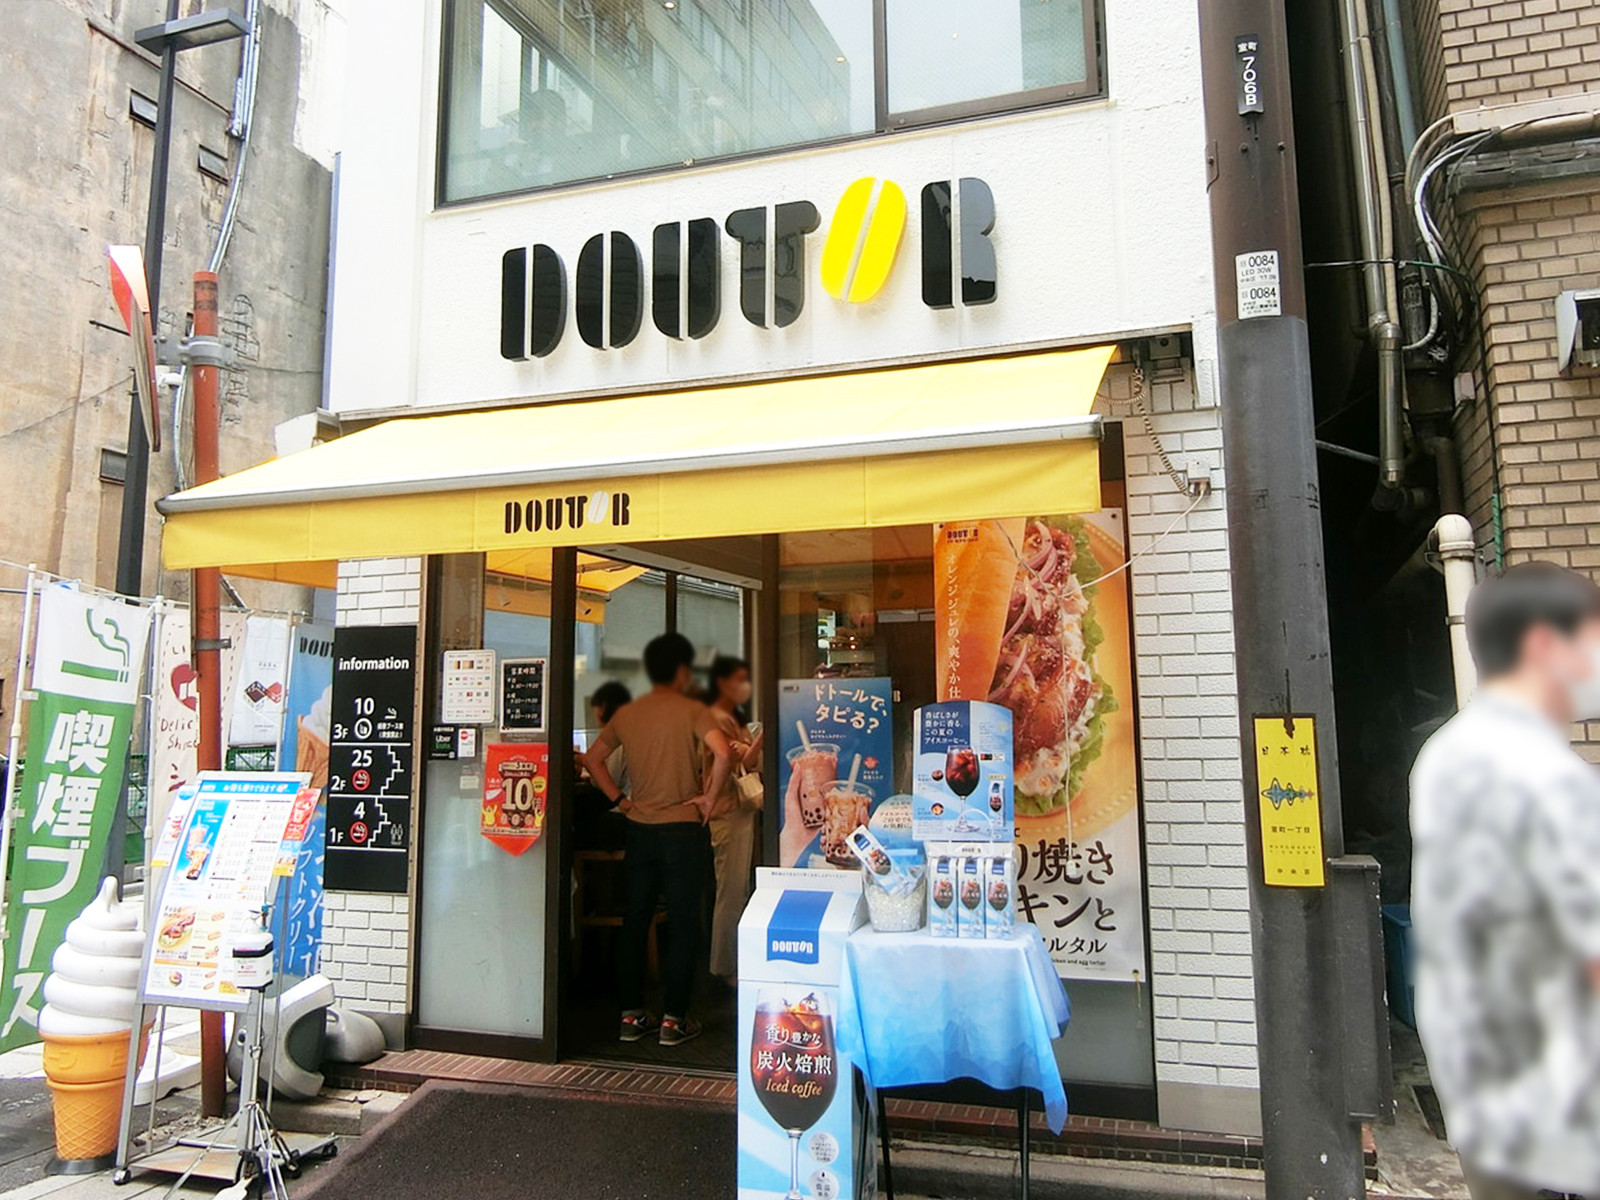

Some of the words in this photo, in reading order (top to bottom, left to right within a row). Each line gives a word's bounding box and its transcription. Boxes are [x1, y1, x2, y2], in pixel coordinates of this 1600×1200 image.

[1242, 56, 1257, 106] 706B
[500, 176, 999, 362] DOUTOR
[1249, 254, 1275, 267] 0084
[1241, 268, 1255, 276] LED
[1250, 287, 1276, 300] 0084
[505, 490, 630, 534] DOUTOR
[339, 656, 410, 671] information
[354, 697, 375, 716] 10
[333, 723, 349, 739] 3F
[351, 749, 373, 767] 25
[331, 775, 346, 791] 2F
[501, 777, 534, 811] 10
[354, 801, 365, 819] 4
[329, 827, 344, 844] 1F
[1, 709, 116, 1038] 喫煙ブース
[772, 940, 814, 954] DOUTOR
[1041, 936, 1108, 956] ルタル
[765, 1023, 823, 1050] 香り豊かな
[756, 1050, 833, 1076] 炭火焙煎
[765, 1076, 790, 1094] Iced
[791, 1080, 823, 1099] coffee
